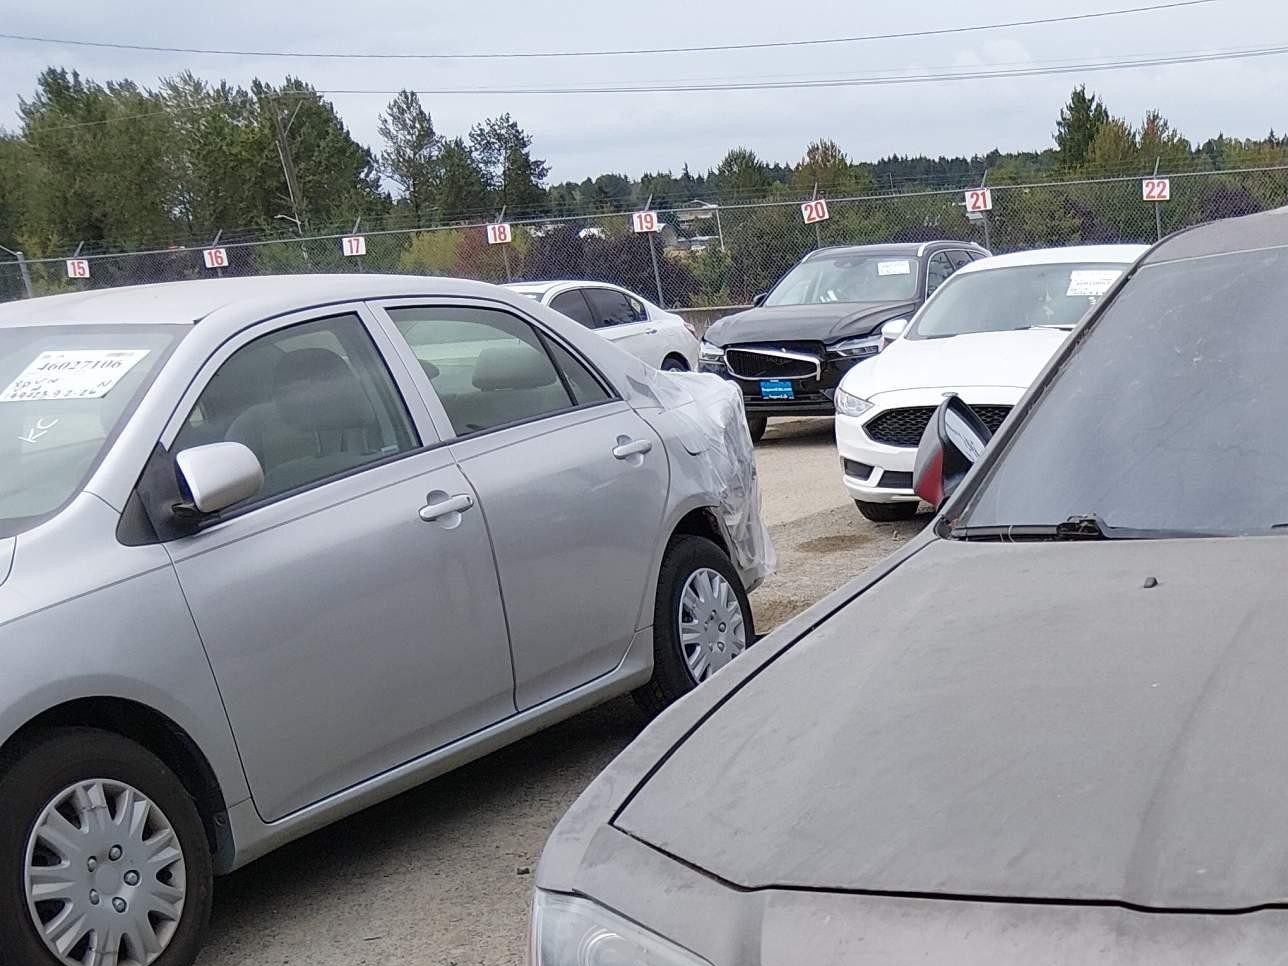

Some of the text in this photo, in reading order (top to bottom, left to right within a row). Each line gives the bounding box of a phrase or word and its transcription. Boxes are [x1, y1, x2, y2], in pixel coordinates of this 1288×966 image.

[1145, 181, 1167, 199] 22
[970, 191, 987, 210] 21
[804, 201, 826, 222] 20
[636, 214, 654, 230] 19
[491, 225, 507, 242] 18
[348, 239, 360, 254] 17
[207, 250, 224, 266] 16
[70, 262, 85, 276] 15
